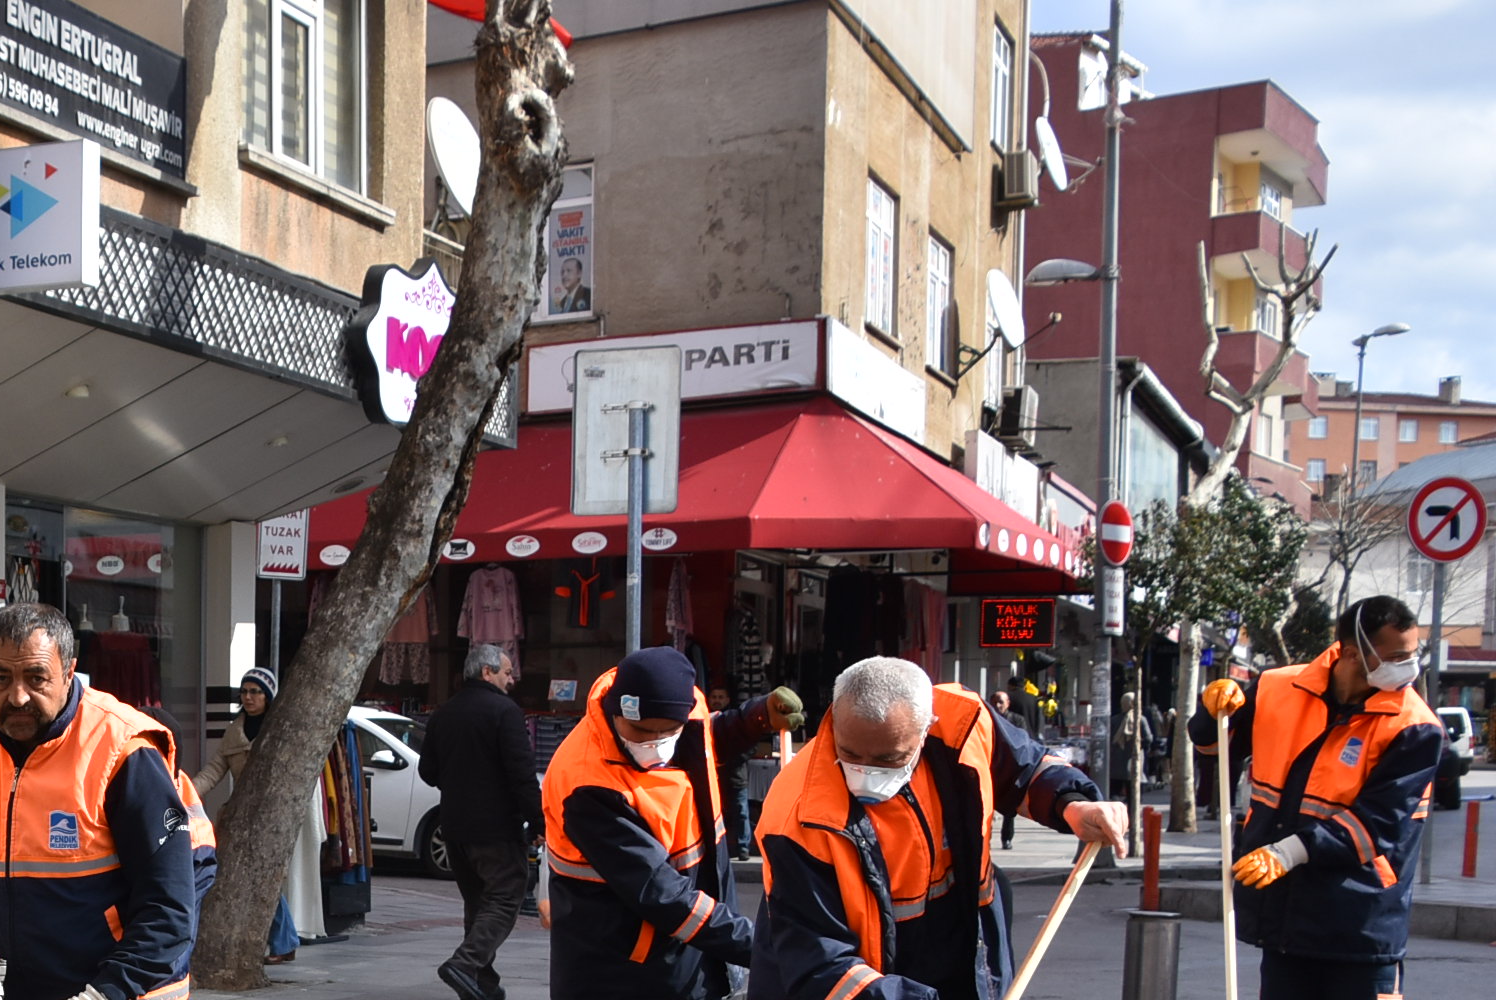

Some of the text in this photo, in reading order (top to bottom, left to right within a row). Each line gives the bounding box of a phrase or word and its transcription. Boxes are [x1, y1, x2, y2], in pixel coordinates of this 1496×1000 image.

[8, 77, 29, 104] 596
[29, 88, 43, 110] 09
[44, 93, 59, 117] 94
[10, 252, 72, 270] Telekom
[264, 526, 301, 538] TUZAK
[270, 545, 294, 556] VAR
[995, 604, 1039, 616] TAVUK
